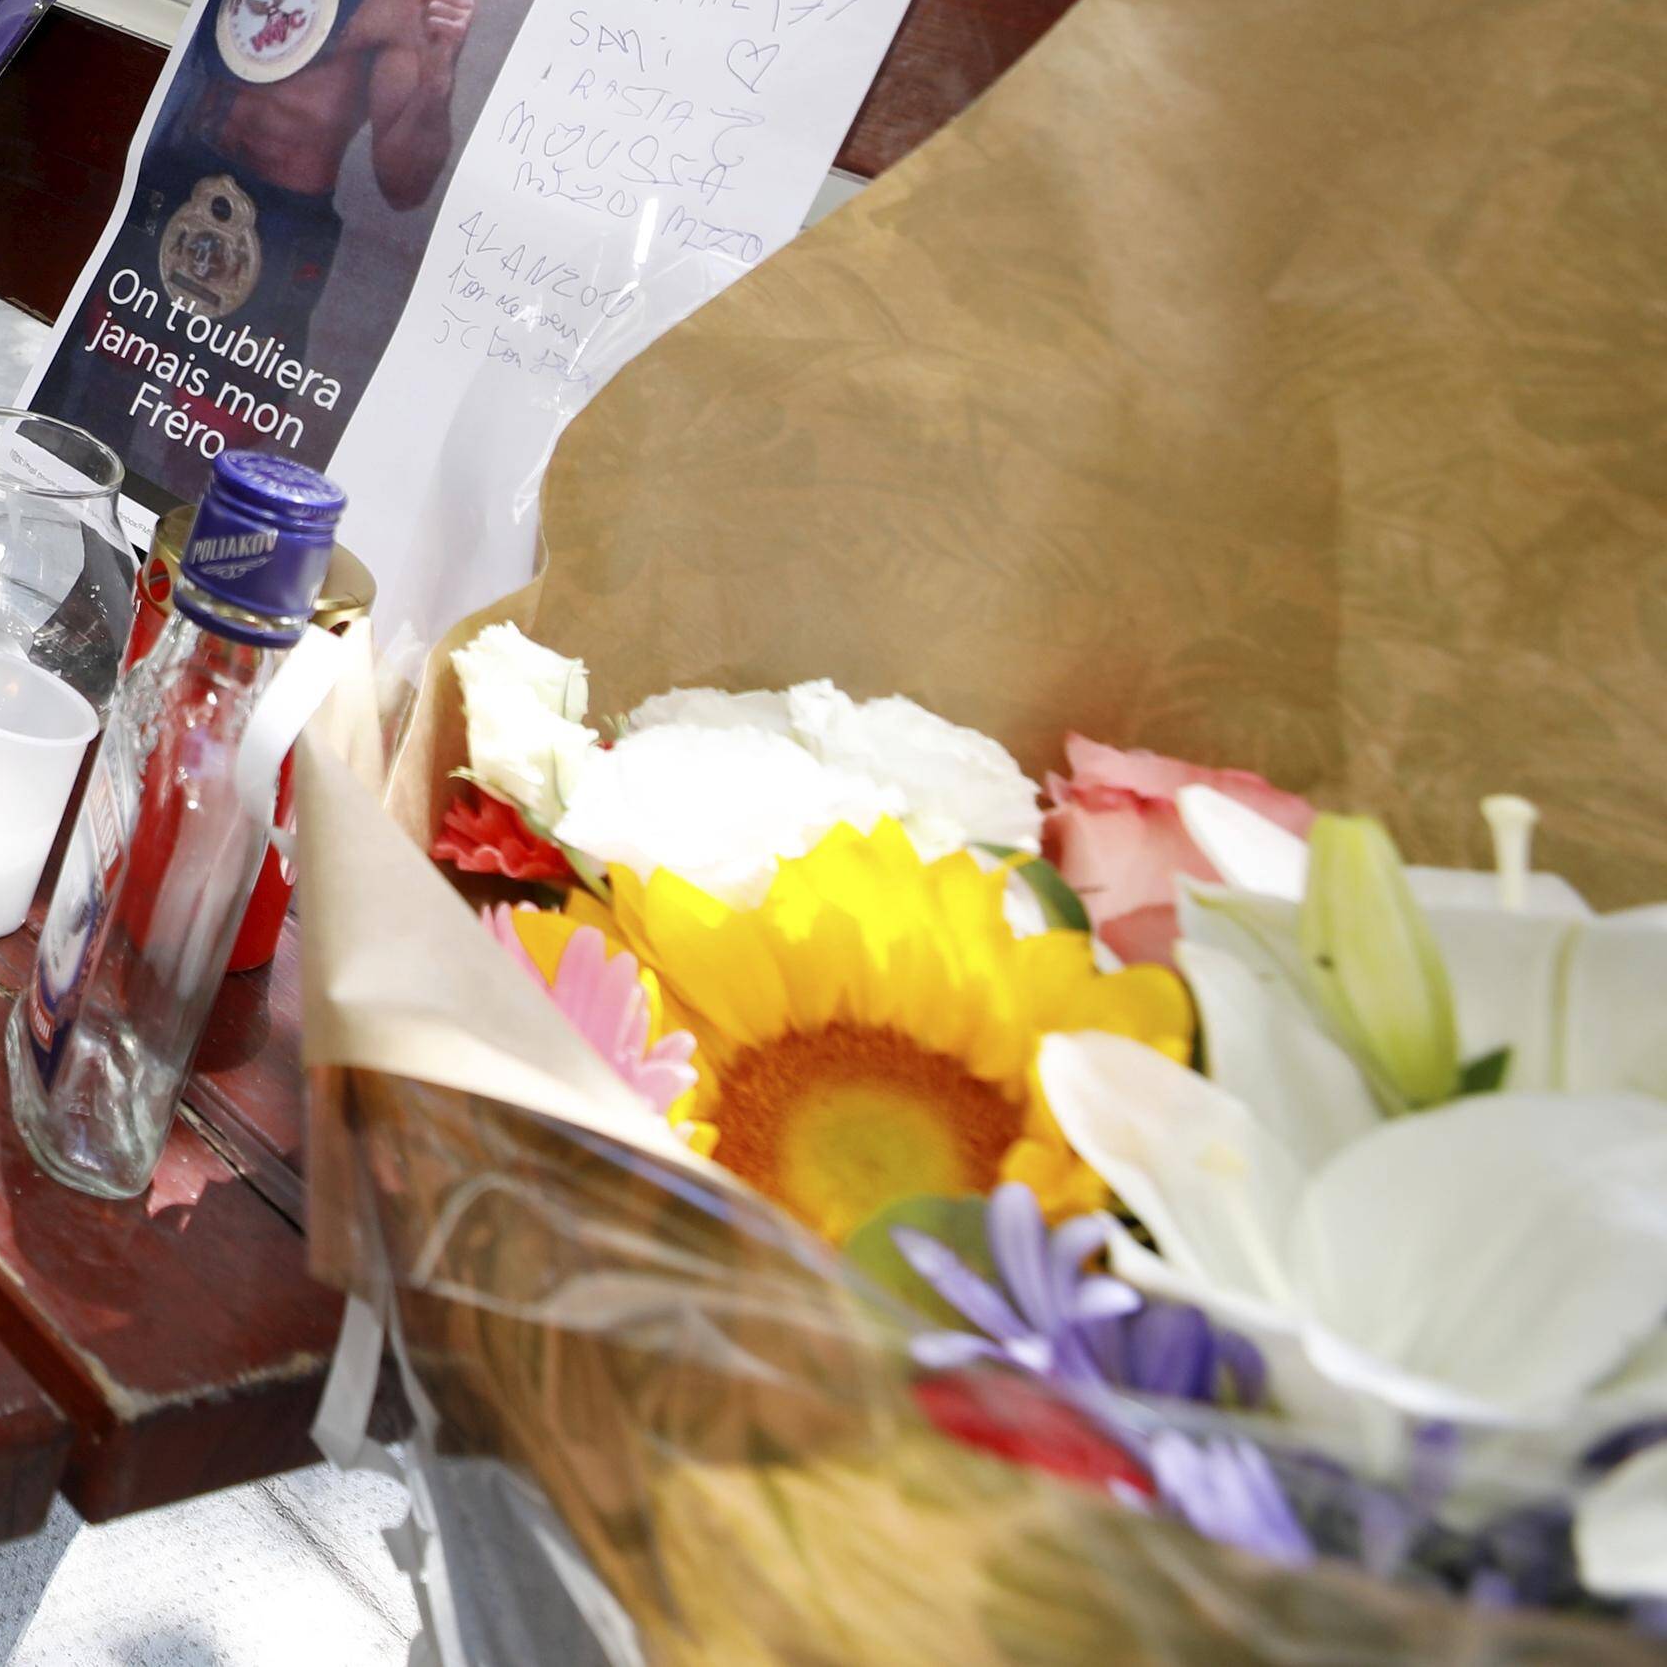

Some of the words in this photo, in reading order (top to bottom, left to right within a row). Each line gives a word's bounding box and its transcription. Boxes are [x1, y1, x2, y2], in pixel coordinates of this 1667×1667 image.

[84, 312, 210, 398] jamais
[214, 381, 305, 449] mon
[107, 268, 159, 320] On
[165, 295, 342, 411] t'oubliera
[128, 381, 226, 461] Fréro
[191, 528, 279, 565] POLIAKOV
